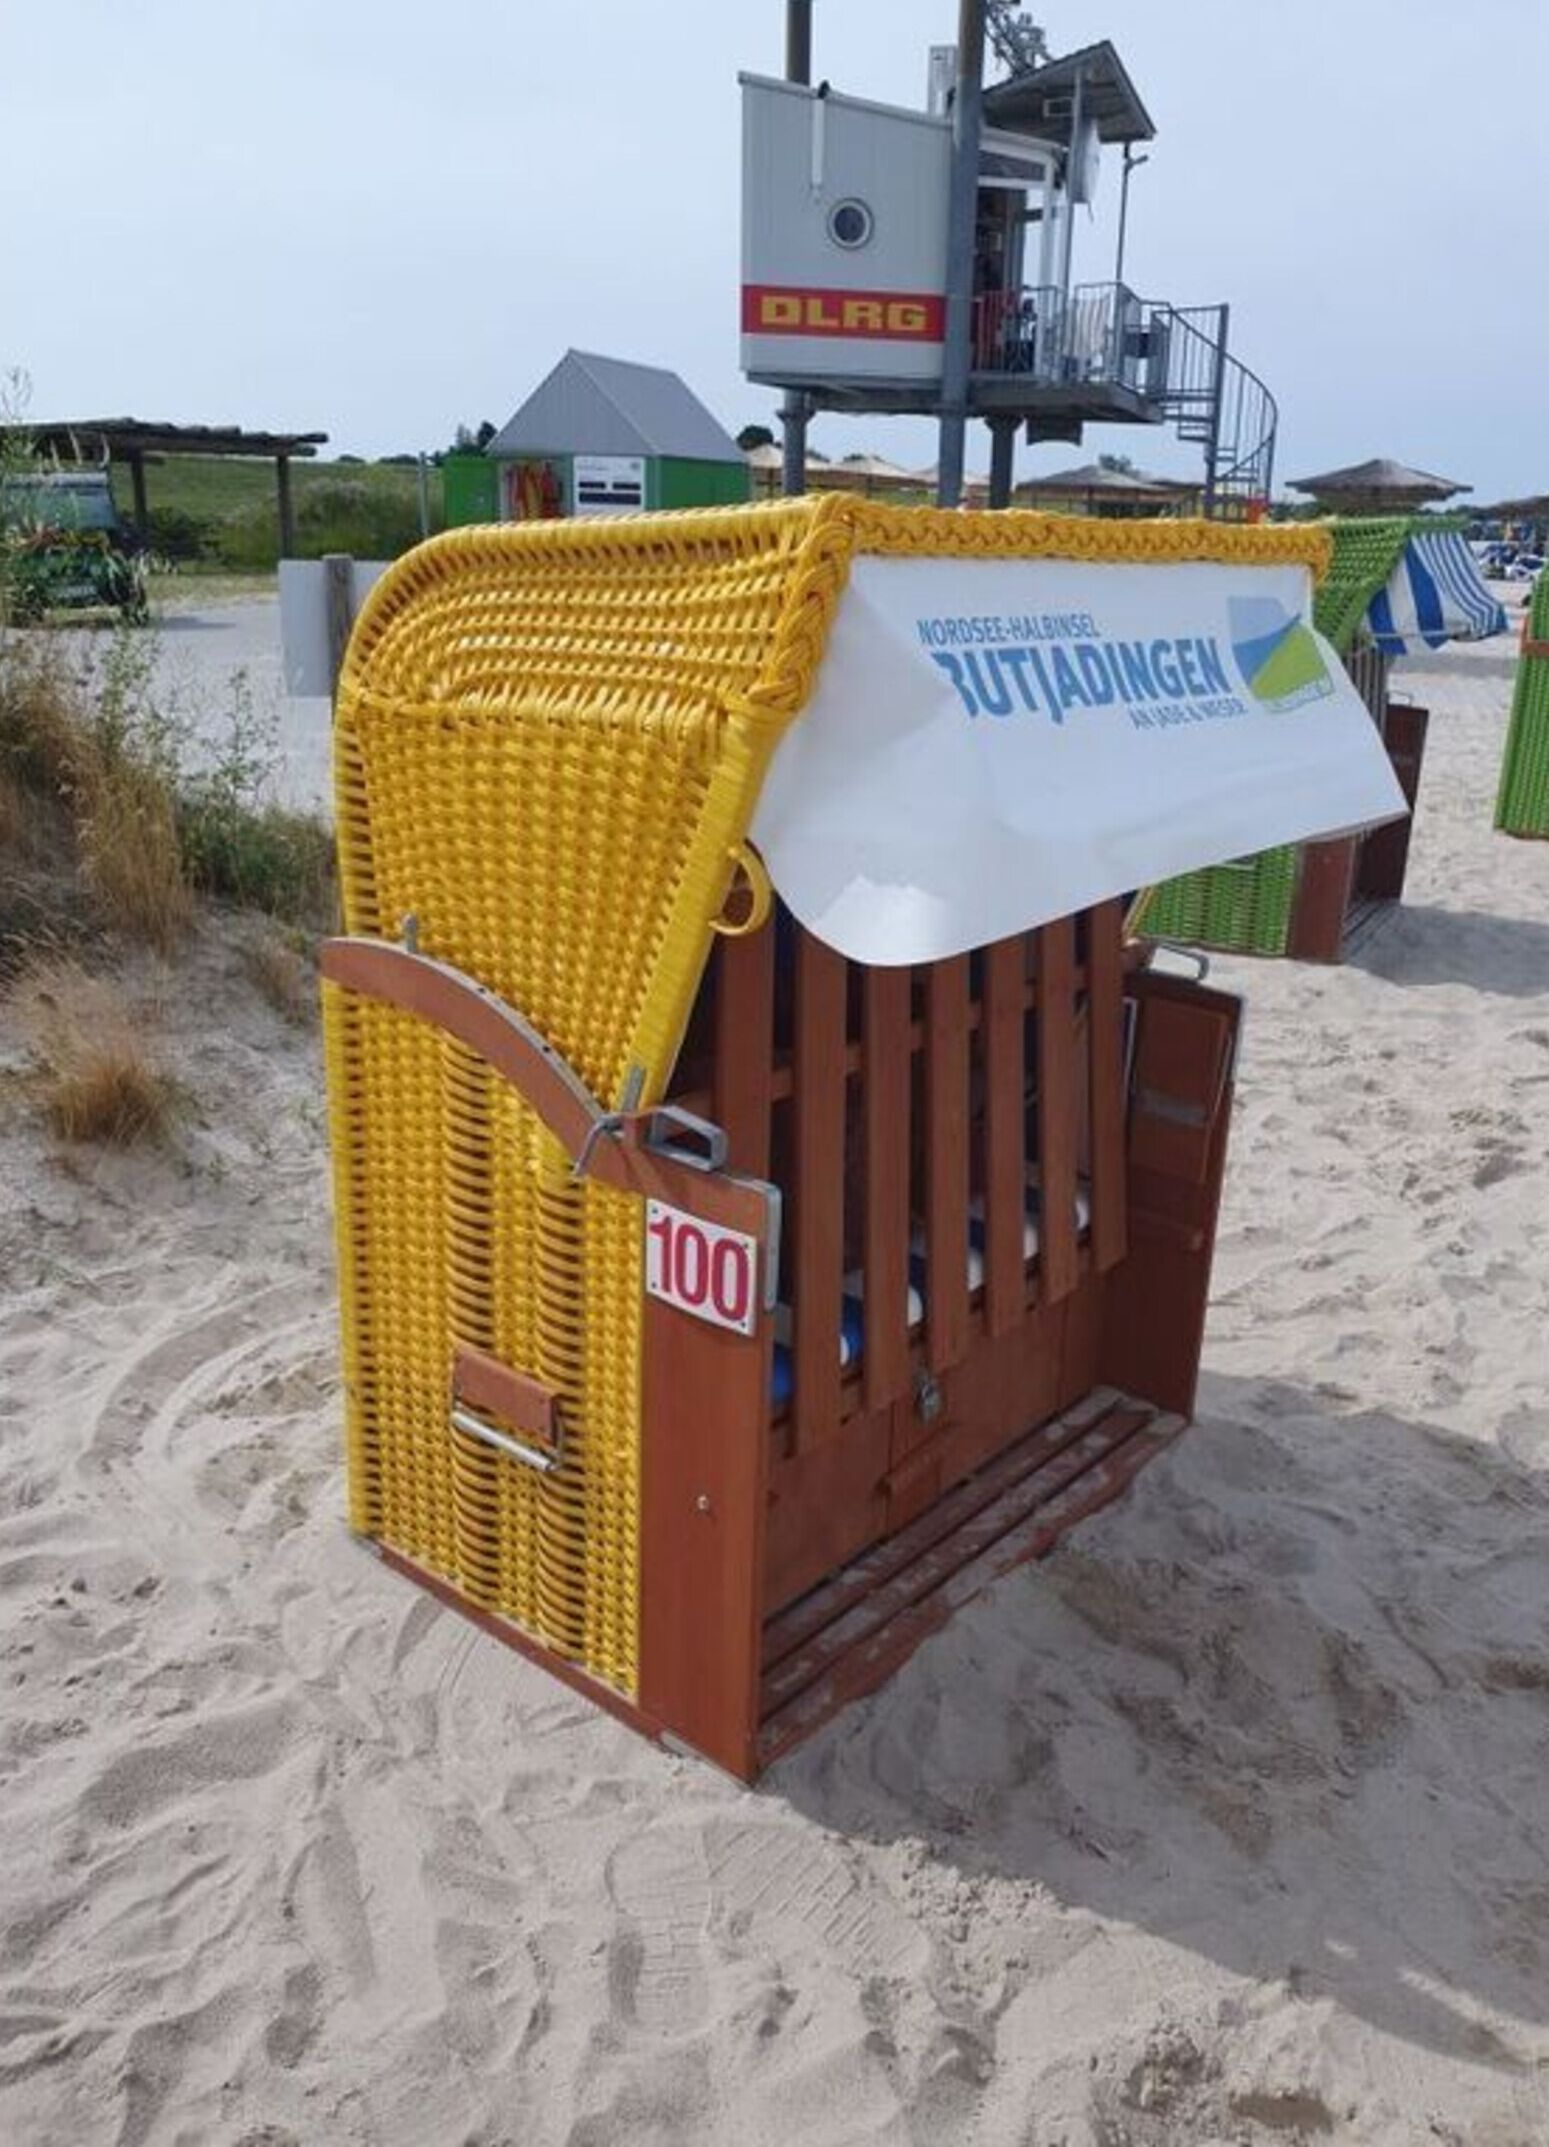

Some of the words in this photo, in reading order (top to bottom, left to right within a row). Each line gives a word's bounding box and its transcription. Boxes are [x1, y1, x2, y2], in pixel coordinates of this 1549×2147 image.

[762, 296, 927, 332] DLRG
[916, 613, 1100, 646] NORDSEE-HALBINSEL
[649, 1216, 749, 1321] 100
